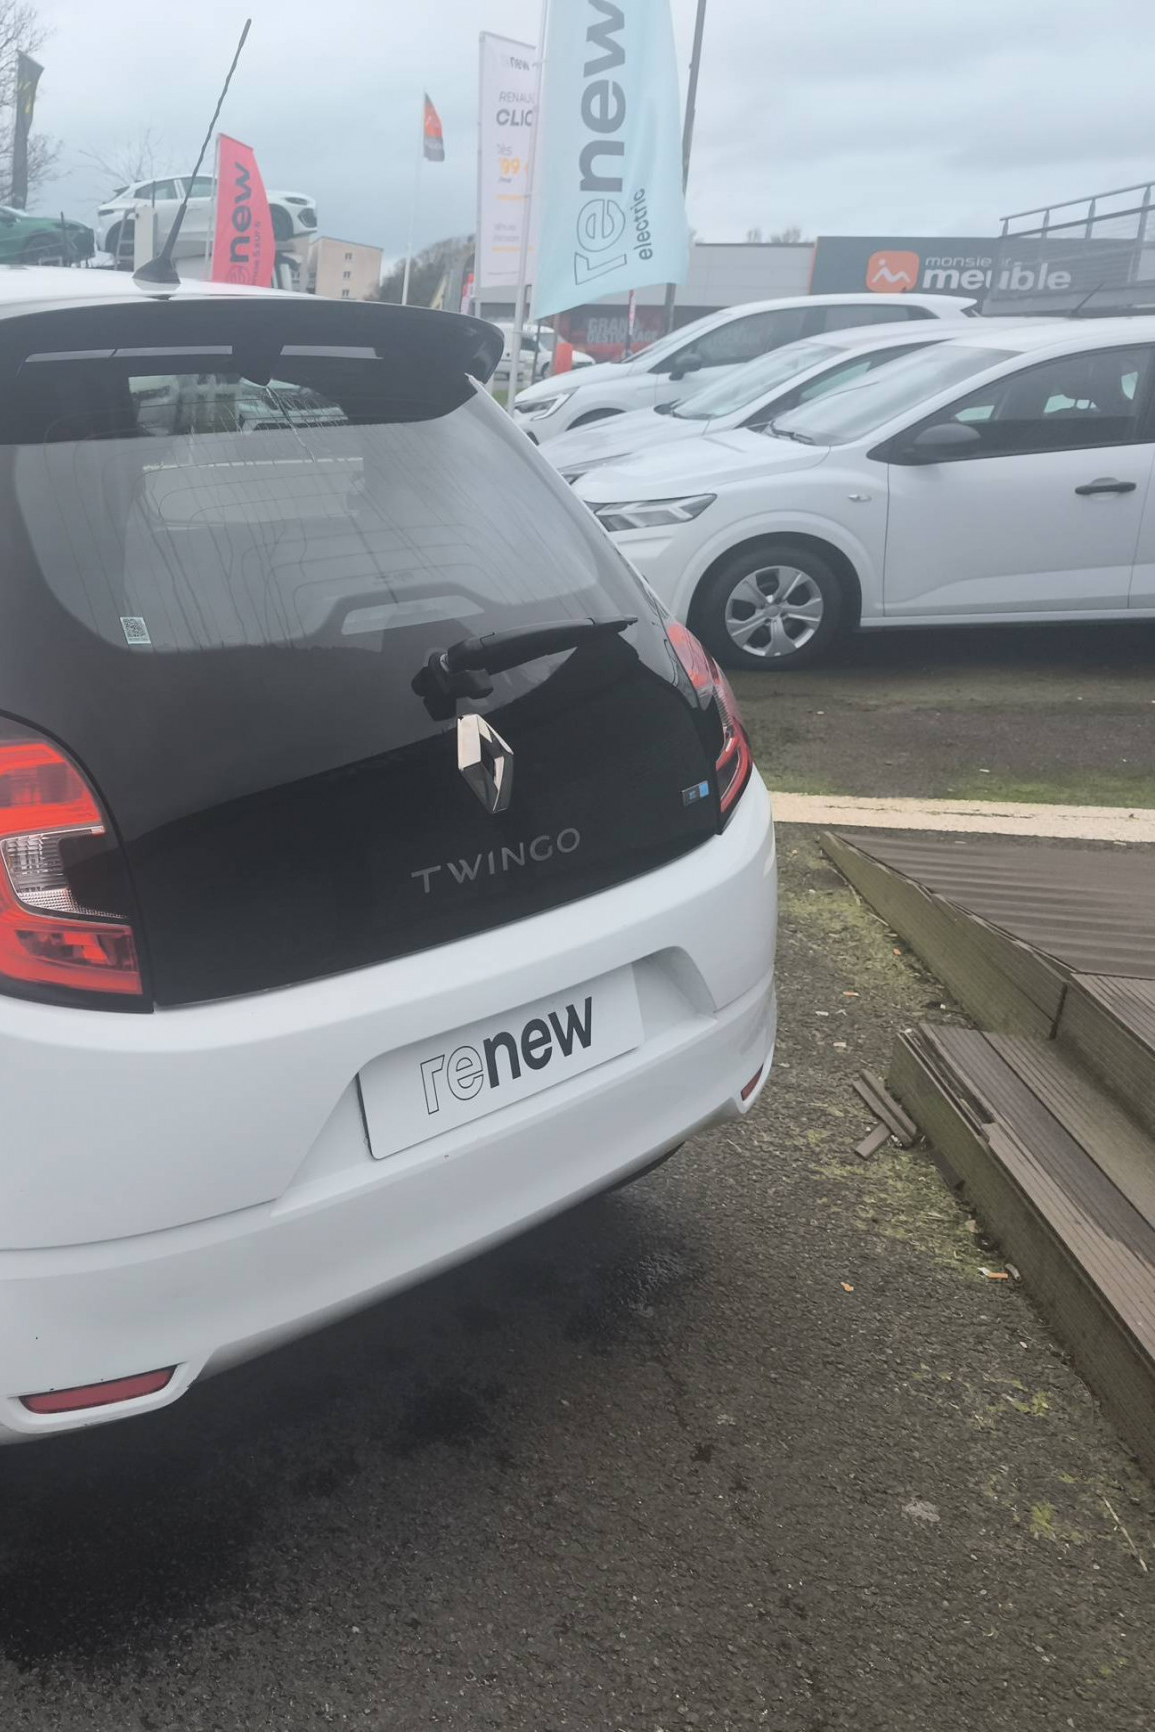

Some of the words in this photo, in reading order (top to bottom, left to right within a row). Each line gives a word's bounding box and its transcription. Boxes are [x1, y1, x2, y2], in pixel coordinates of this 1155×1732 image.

[574, 0, 628, 286] renew
[630, 188, 653, 261] electric
[922, 262, 1072, 290] meuble
[411, 827, 581, 894] TWINGO
[419, 996, 593, 1115] renew
